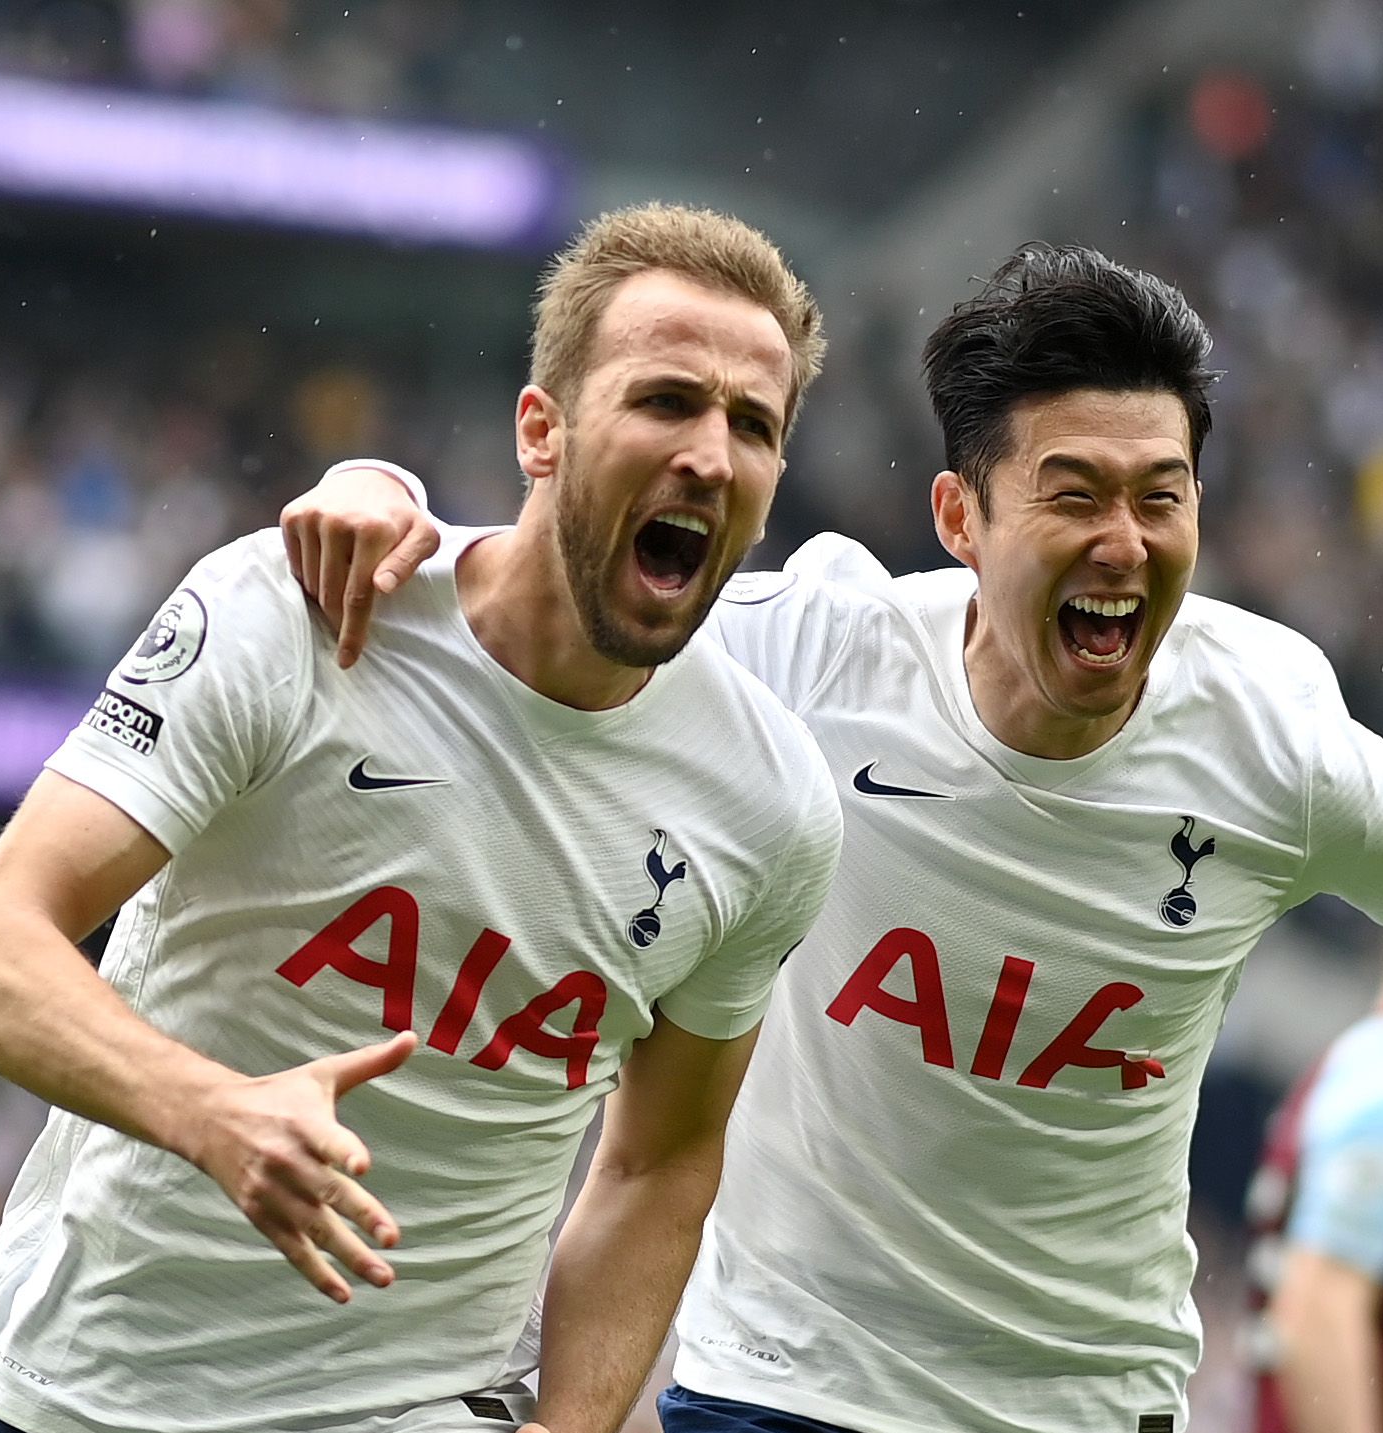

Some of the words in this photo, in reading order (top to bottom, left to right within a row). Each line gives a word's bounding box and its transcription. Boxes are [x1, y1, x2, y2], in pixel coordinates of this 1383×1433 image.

[90, 711, 155, 755] racism
[101, 693, 154, 735] room
[274, 885, 608, 1091] AIA
[824, 926, 1166, 1091] AIA
